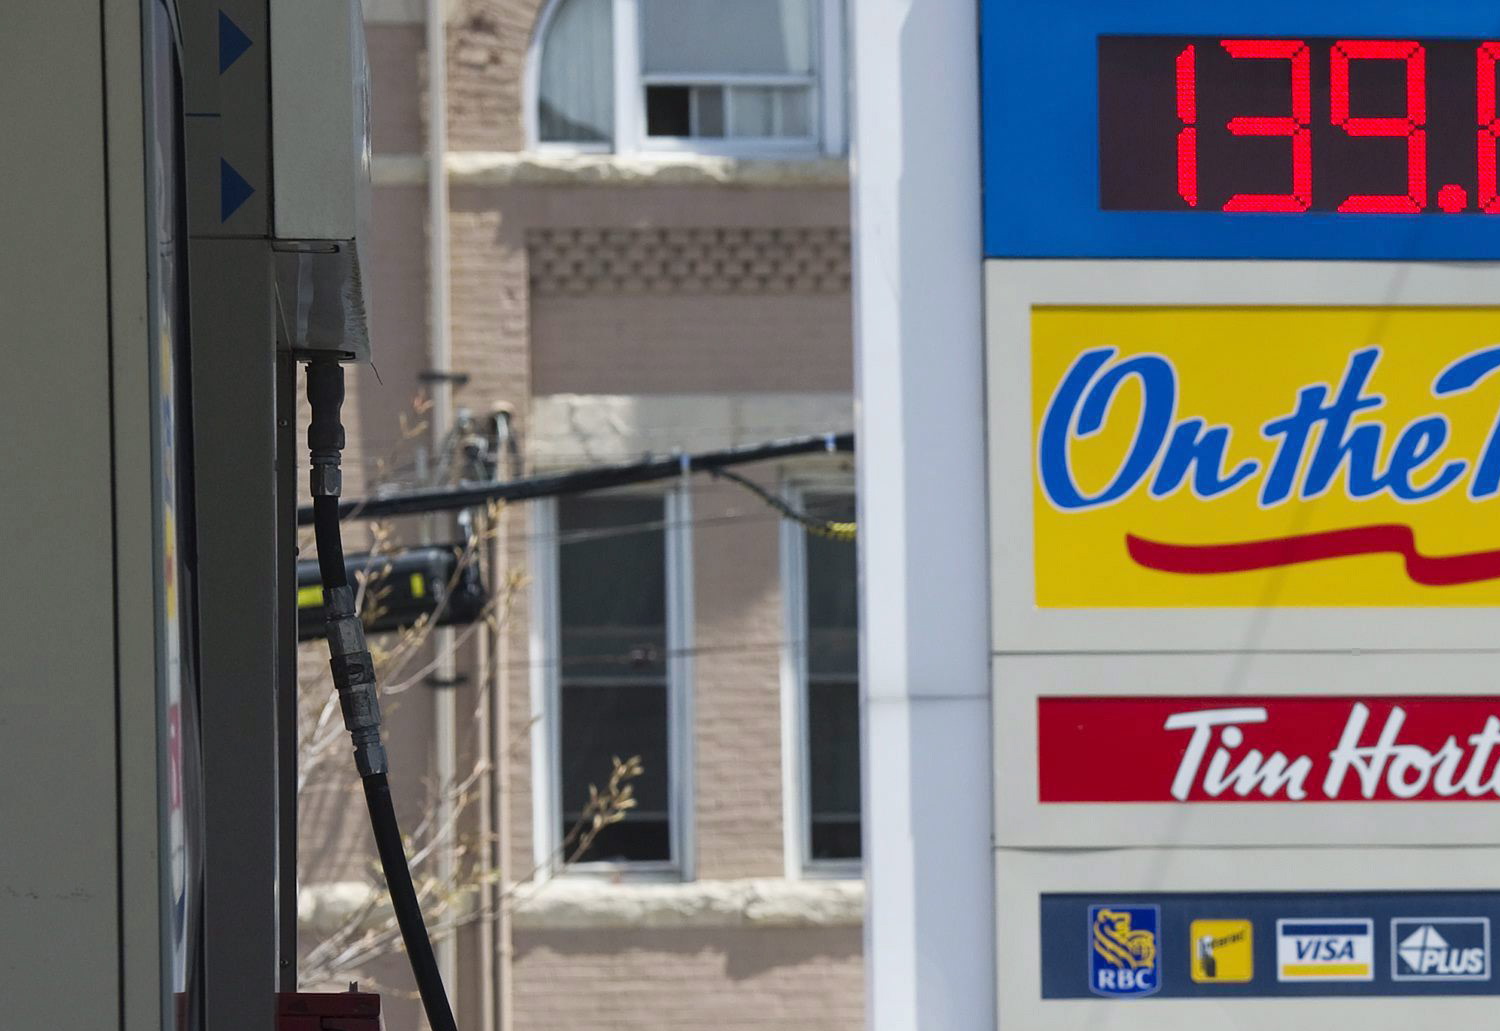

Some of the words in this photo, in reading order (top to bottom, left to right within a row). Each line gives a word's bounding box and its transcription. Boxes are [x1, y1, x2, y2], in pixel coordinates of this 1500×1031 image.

[1038, 345, 1259, 510] On
[1260, 345, 1468, 508] the
[1164, 706, 1314, 801] Tim
[1296, 939, 1355, 961] VISA
[1421, 948, 1485, 974] PLUS
[1097, 968, 1153, 991] RBC
